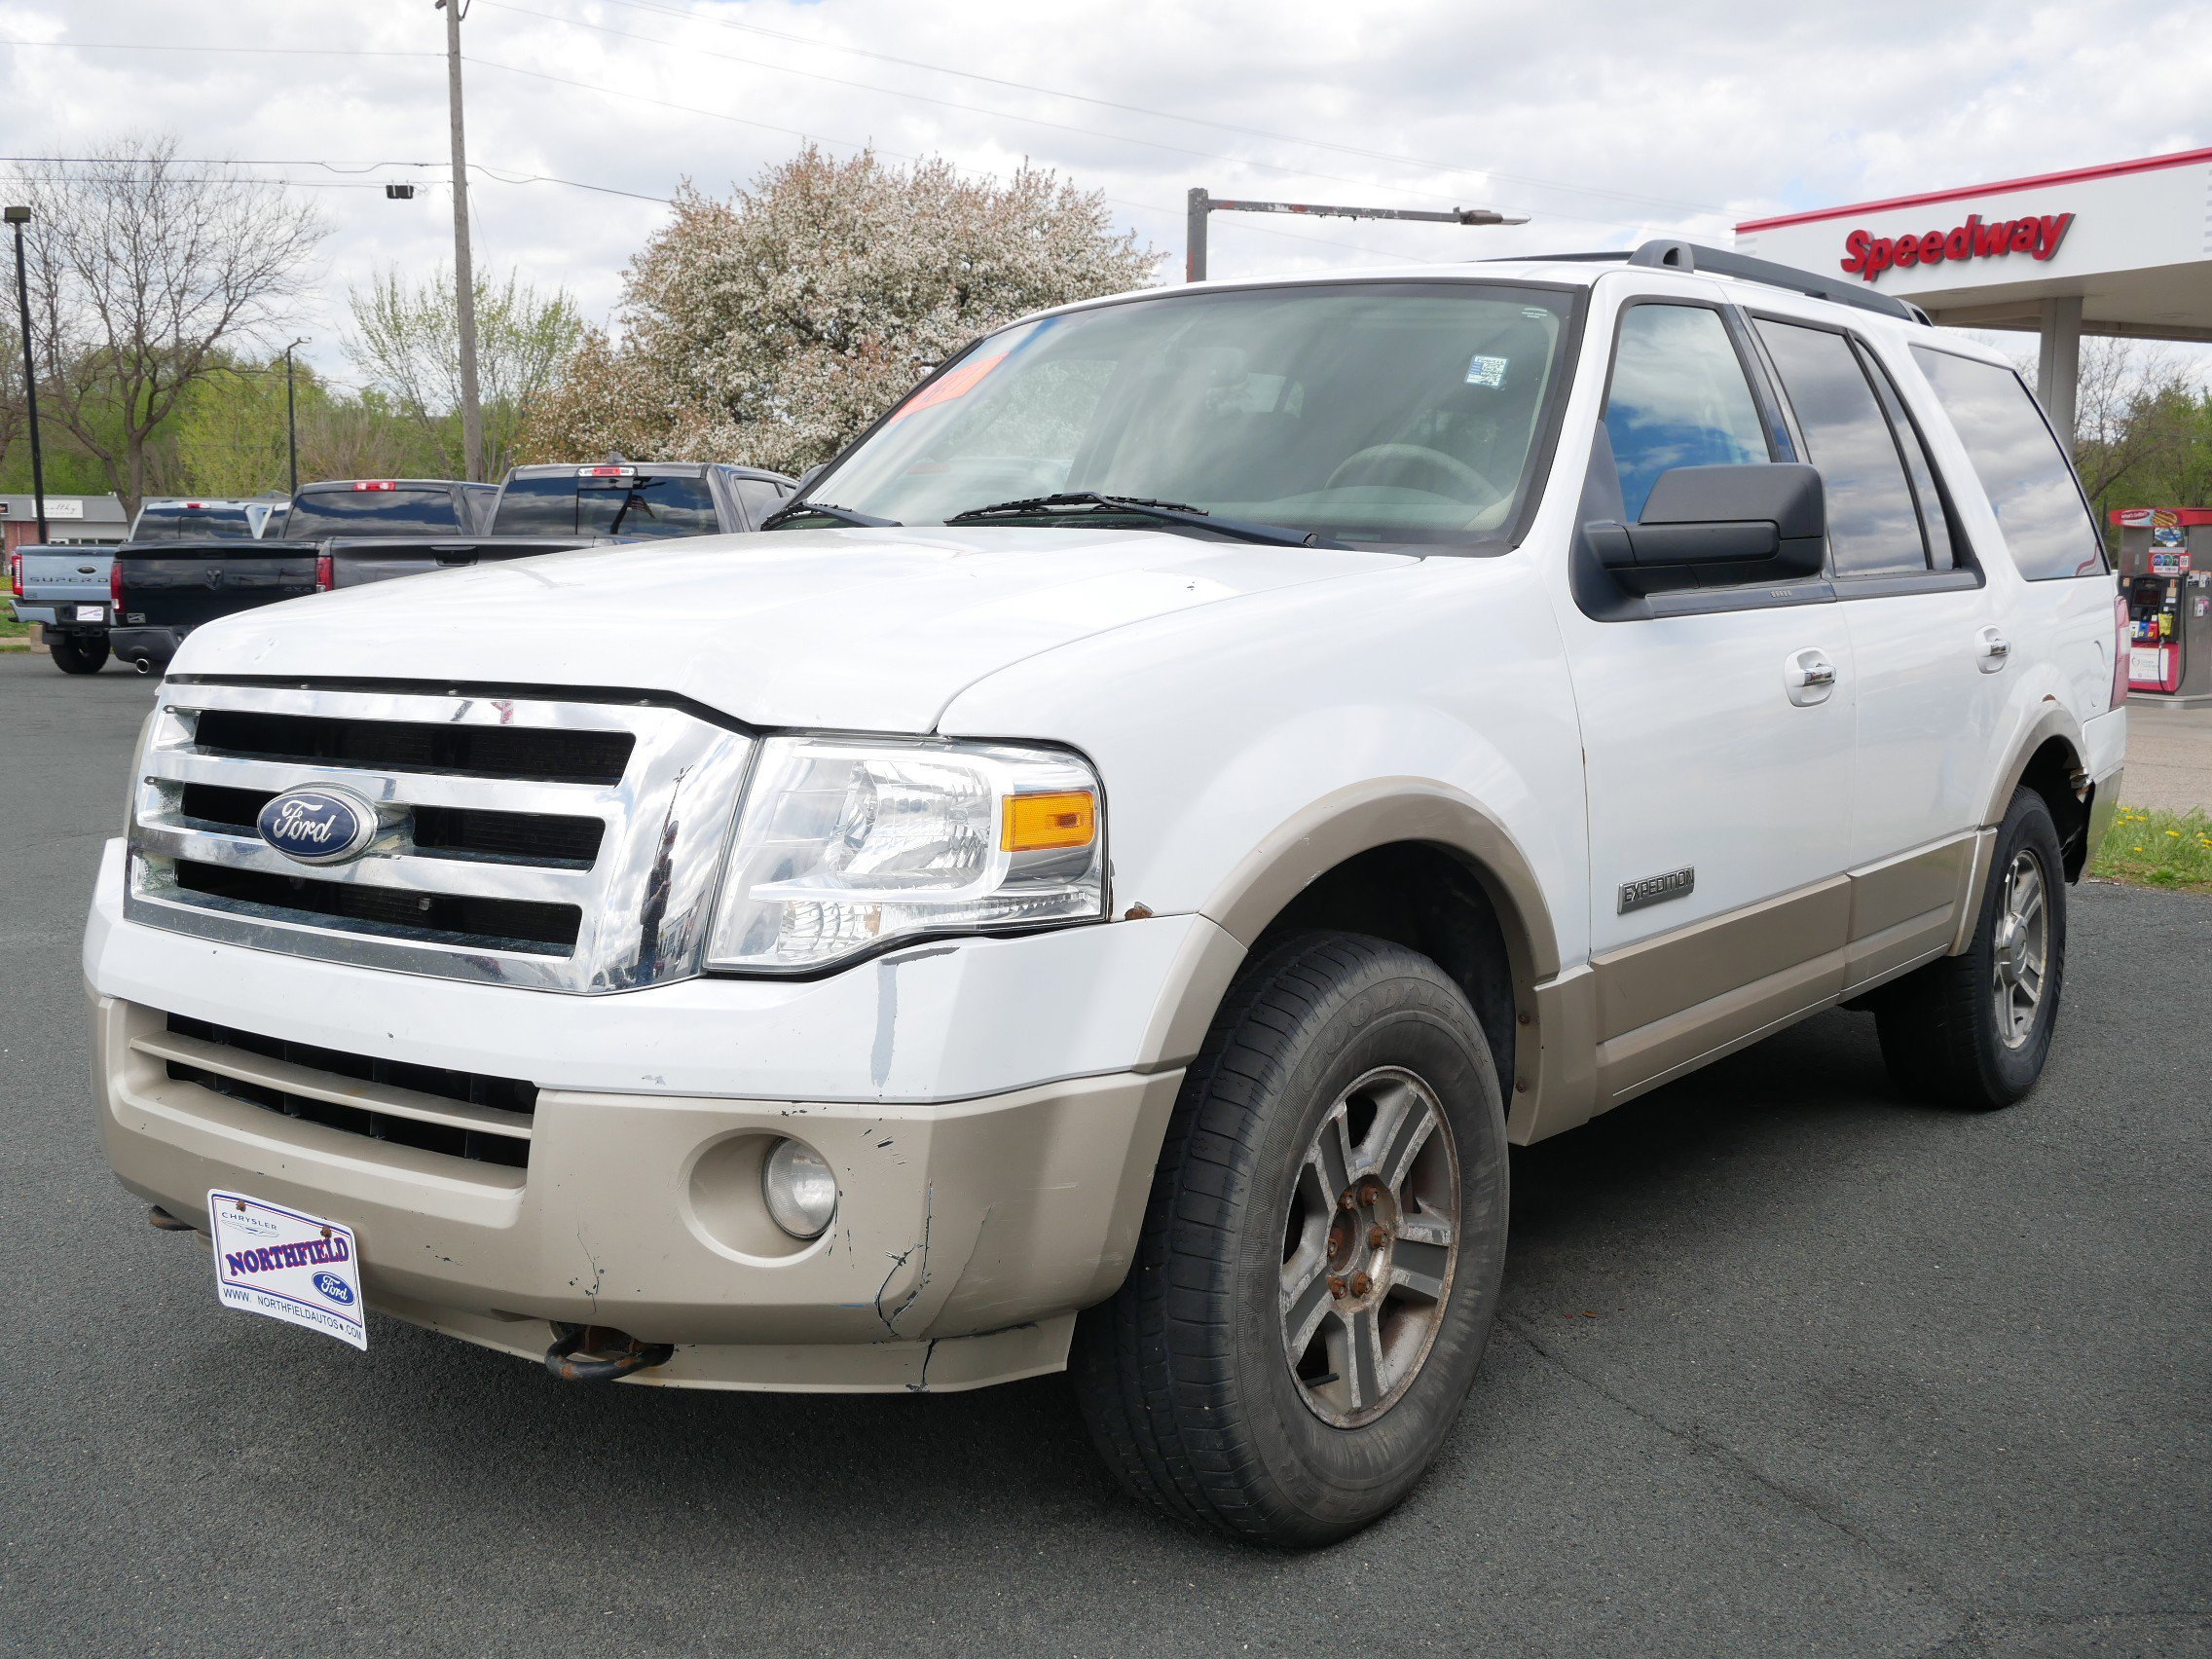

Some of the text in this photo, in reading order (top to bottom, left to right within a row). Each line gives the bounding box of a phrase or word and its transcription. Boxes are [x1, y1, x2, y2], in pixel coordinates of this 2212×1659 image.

[1840, 212, 2076, 281] Speedway
[273, 799, 337, 844] Ford
[1624, 867, 1694, 902] EXPEDITION
[221, 1211, 278, 1231] CHRYSLER
[225, 1236, 350, 1276] NORTHFIELD
[320, 1273, 349, 1301] Ford
